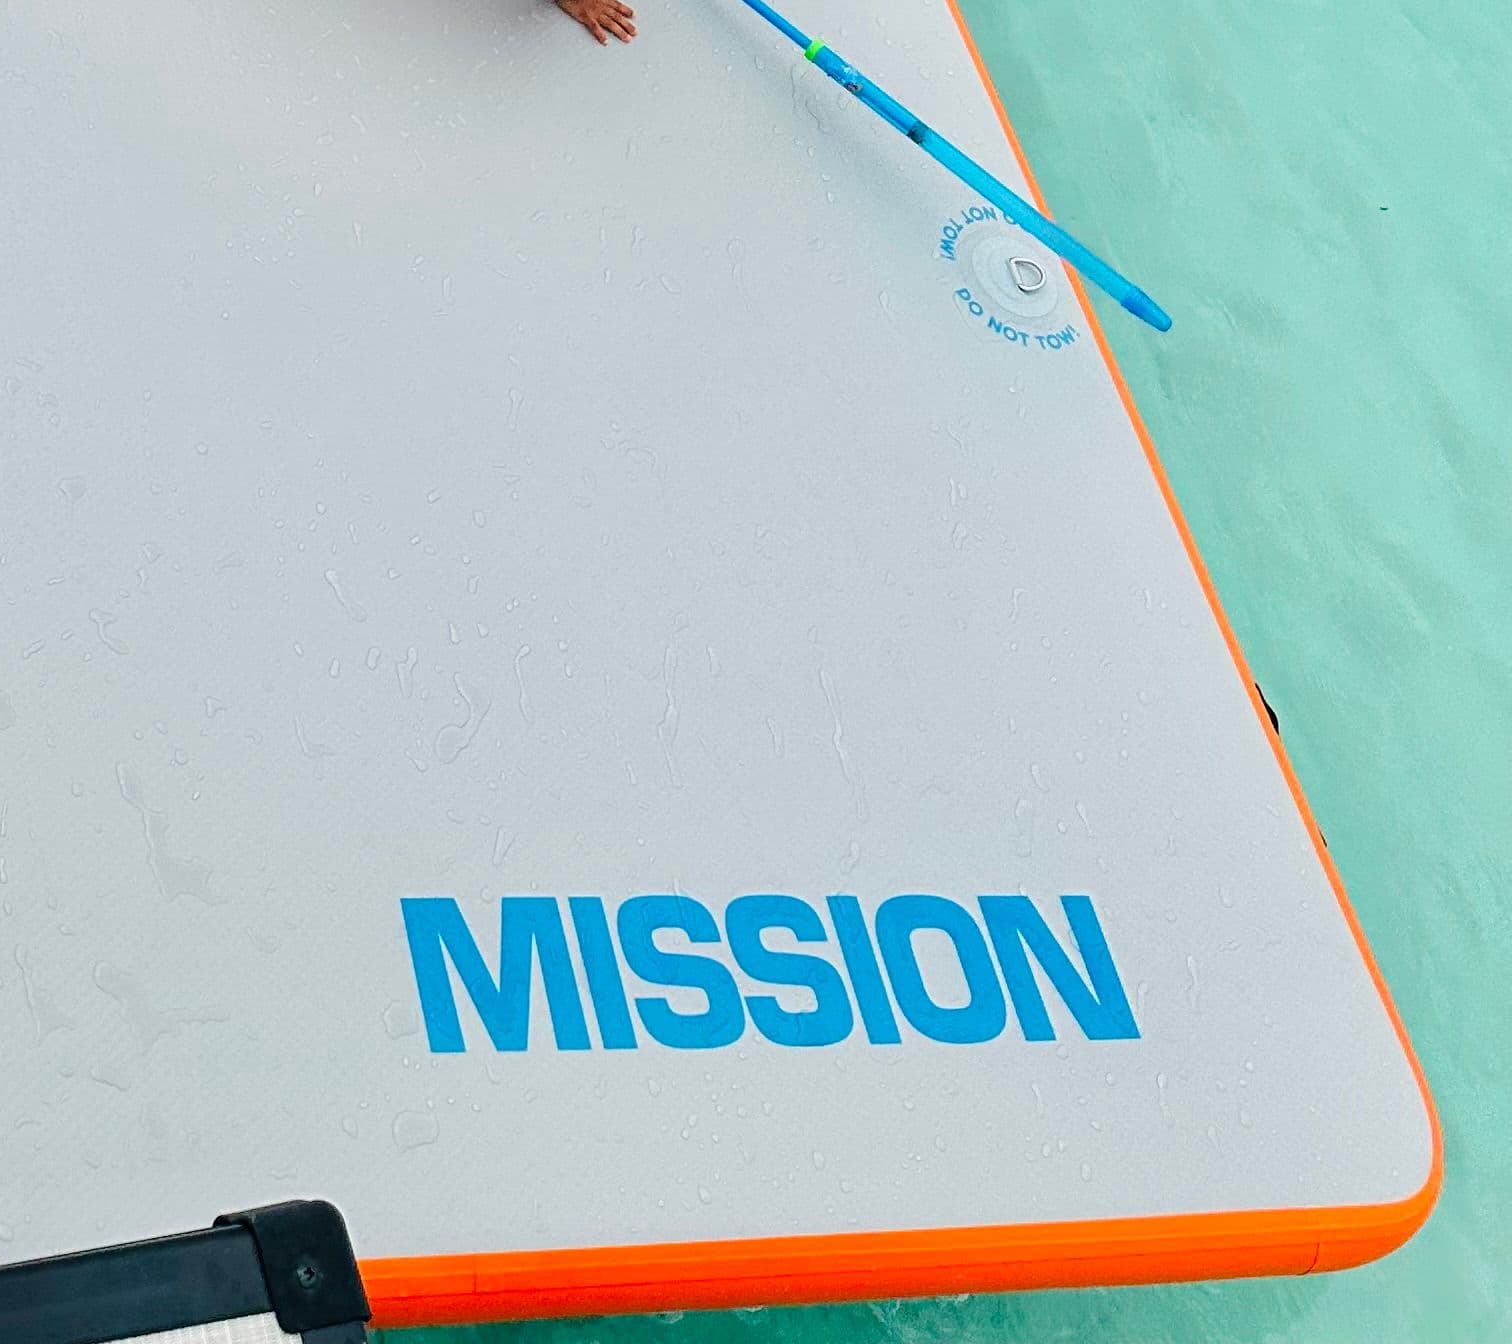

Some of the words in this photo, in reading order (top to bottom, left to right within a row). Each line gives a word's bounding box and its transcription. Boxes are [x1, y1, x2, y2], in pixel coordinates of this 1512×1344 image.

[961, 205, 998, 225] NOT
[955, 288, 984, 316] DO
[987, 316, 1030, 347] NOT
[1034, 324, 1080, 350] TOW!
[399, 894, 1142, 1053] MISSION
